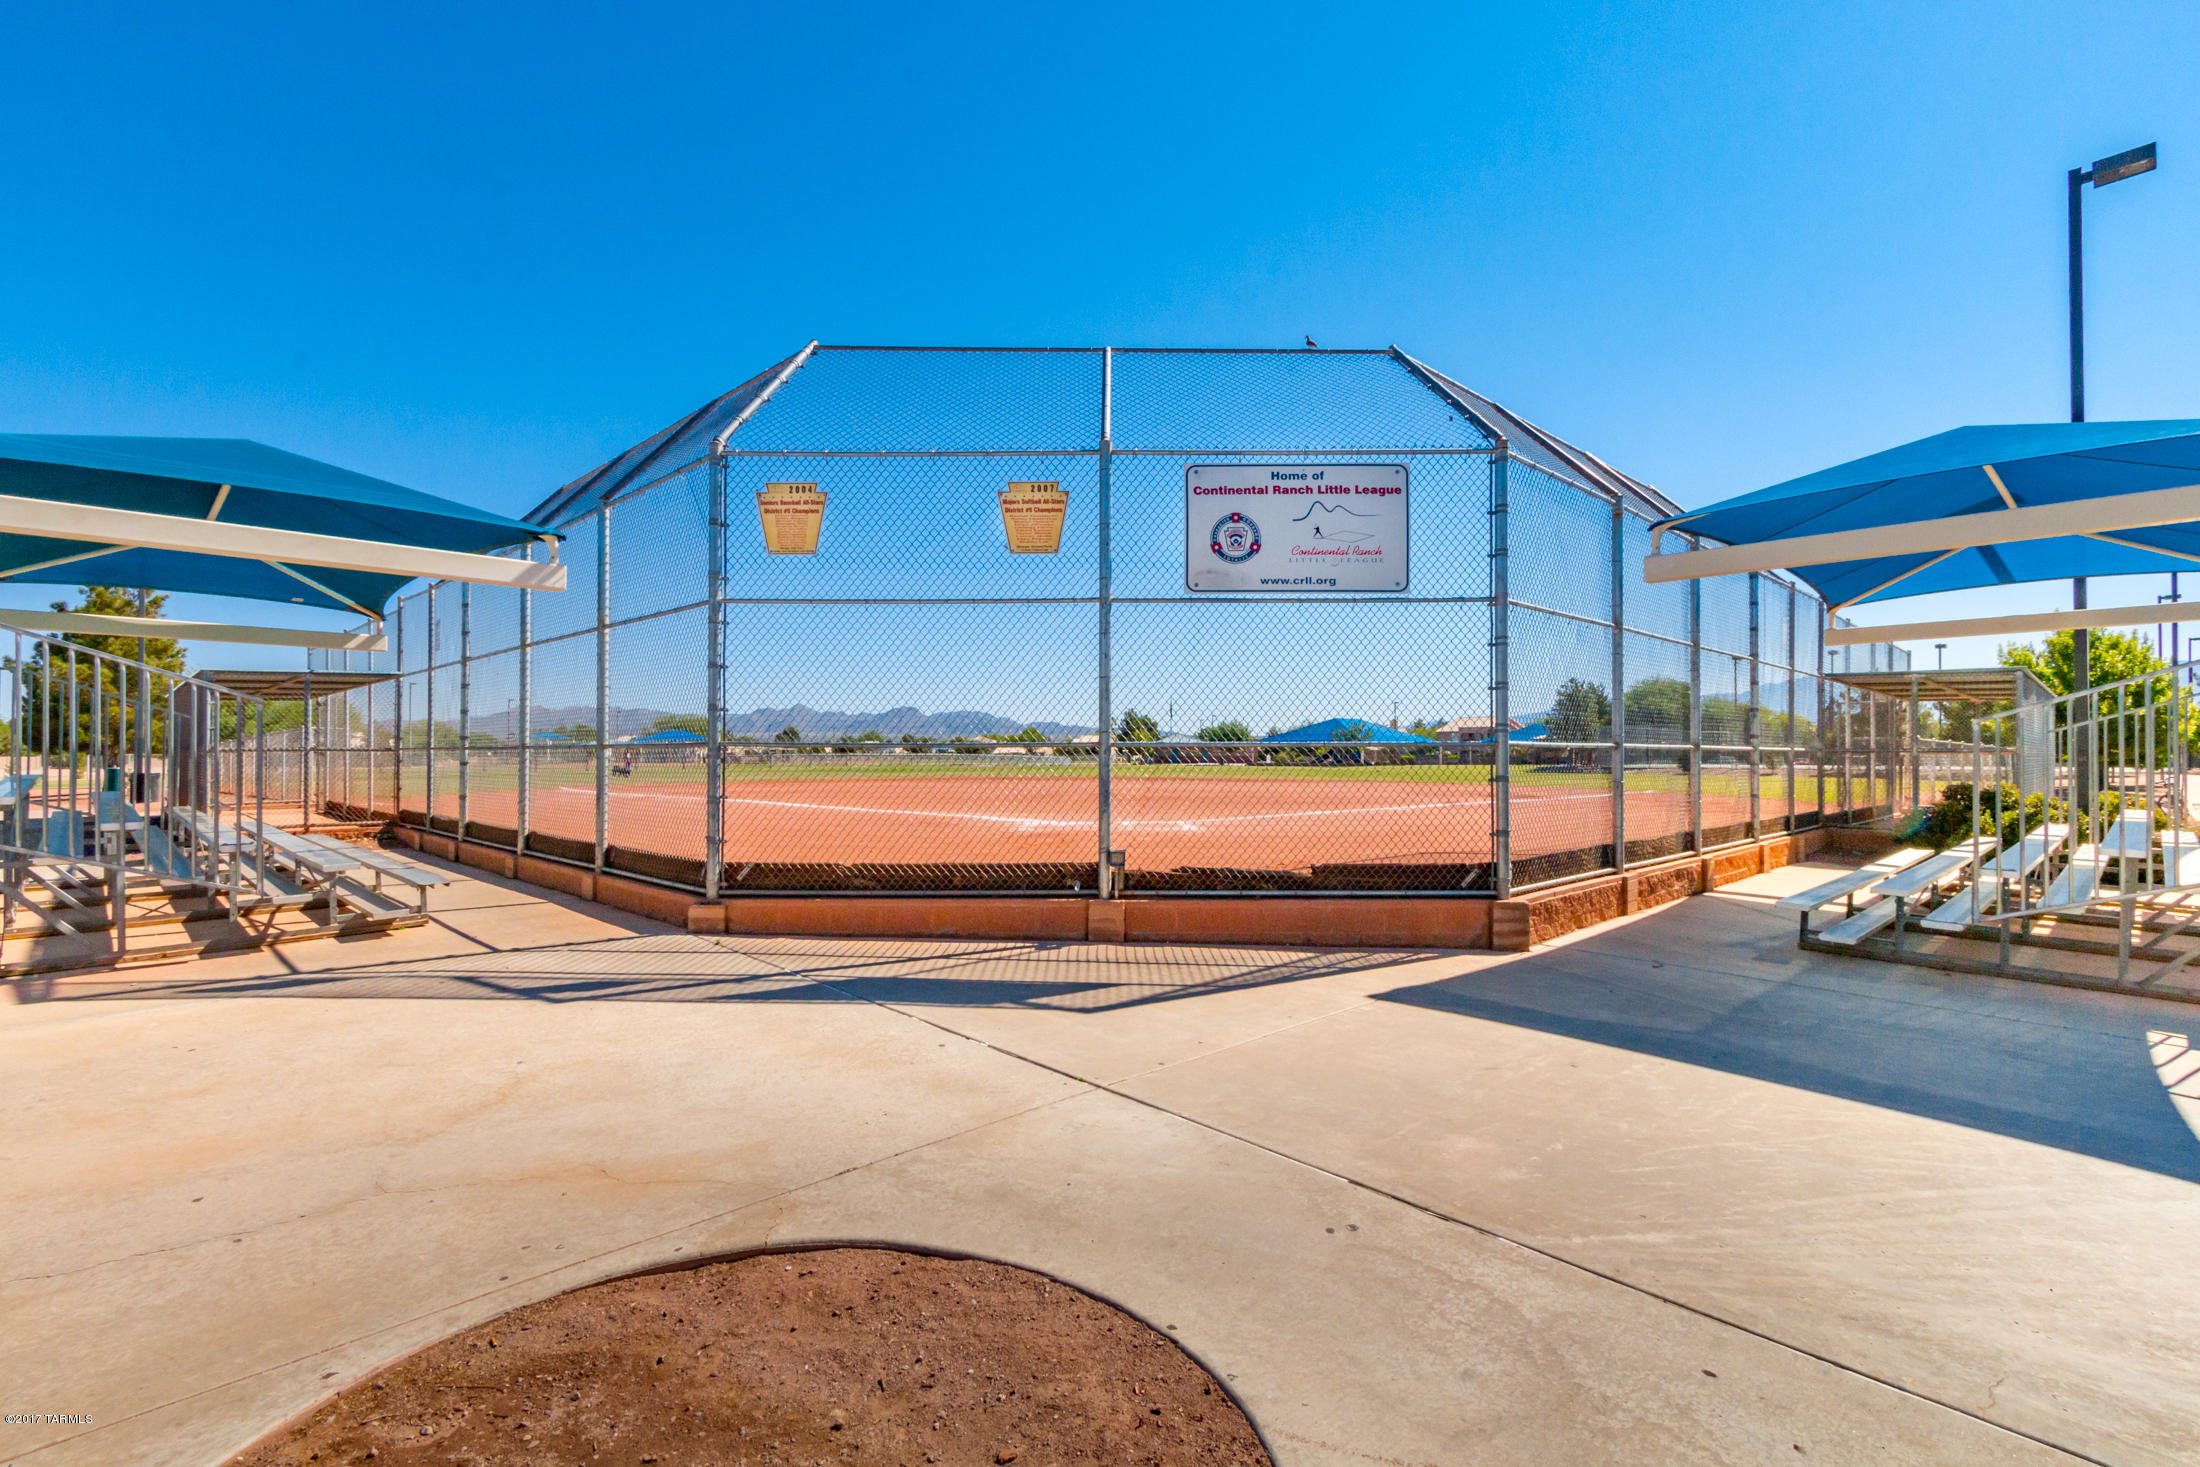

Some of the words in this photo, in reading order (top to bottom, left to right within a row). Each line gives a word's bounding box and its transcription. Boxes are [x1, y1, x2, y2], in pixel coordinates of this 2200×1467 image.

[1270, 471, 1308, 481] Home
[1312, 471, 1325, 481] of
[788, 485, 813, 494] 2004
[1030, 484, 1055, 493] 2007
[1193, 485, 1269, 496] Continental
[1272, 485, 1314, 495] Ranch
[1317, 485, 1351, 495] Little
[1354, 485, 1402, 497] League
[1291, 545, 1351, 556] Continental
[1351, 545, 1383, 556] Ranch
[1260, 576, 1337, 587] www.crll.org
